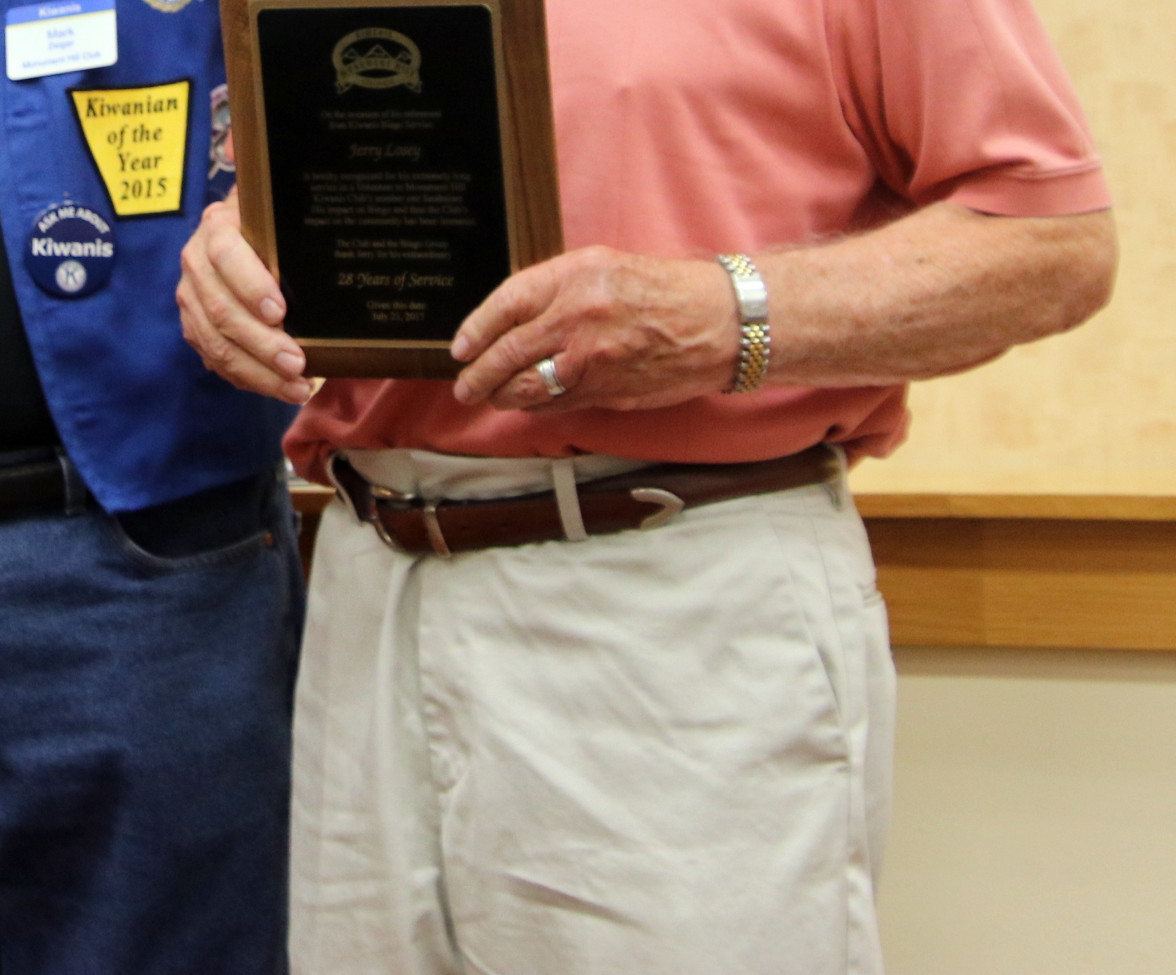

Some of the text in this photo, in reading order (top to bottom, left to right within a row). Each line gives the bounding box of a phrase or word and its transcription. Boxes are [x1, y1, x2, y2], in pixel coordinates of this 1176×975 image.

[86, 95, 178, 118] Kiwanian
[107, 123, 163, 150] of the
[118, 151, 163, 172] Year
[348, 143, 382, 161] Jerry
[120, 177, 168, 200] 2015
[37, 206, 111, 234] ASK ME ABOUT
[31, 237, 114, 257] Kiwanis
[338, 271, 454, 291] 28 Years of Service
